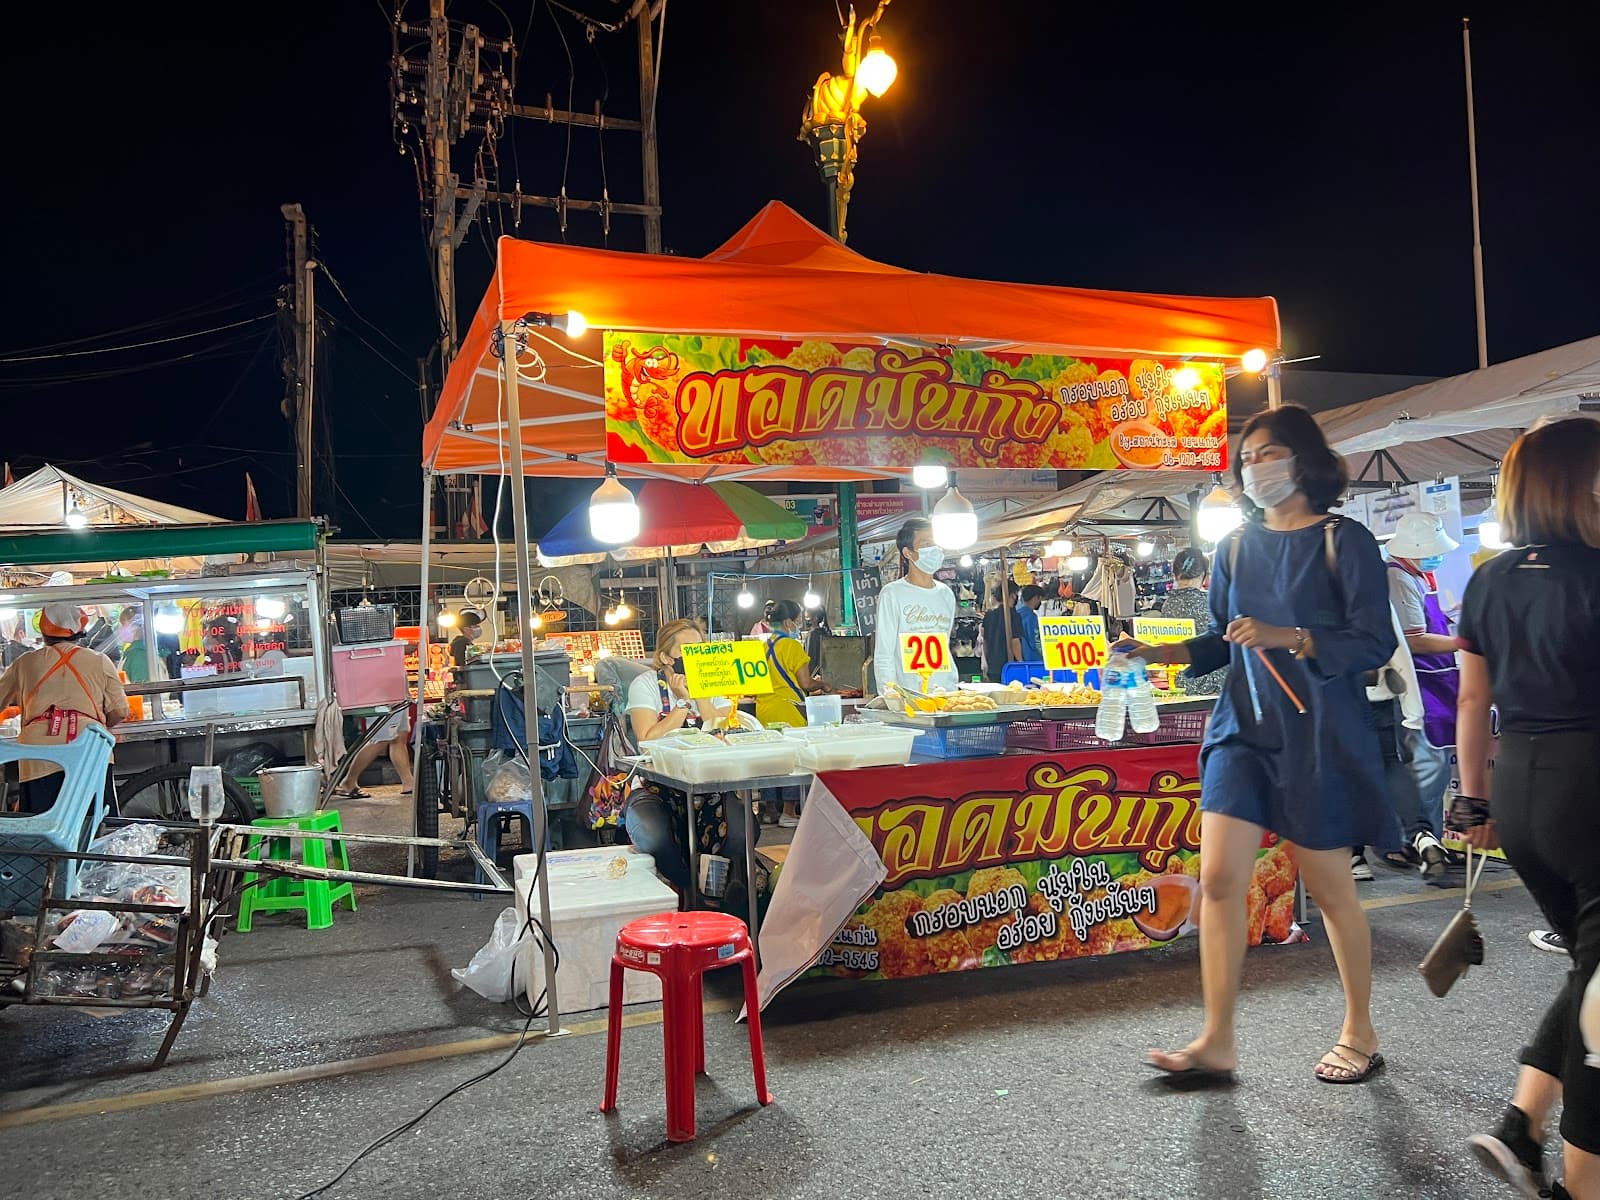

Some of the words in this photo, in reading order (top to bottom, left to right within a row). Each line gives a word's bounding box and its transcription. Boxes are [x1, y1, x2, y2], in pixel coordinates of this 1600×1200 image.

[1060, 377, 1129, 404] กรอบนอก
[1135, 365, 1180, 398] นุ่มใ
[680, 353, 1058, 454] ทอดมันกุ้ง
[1111, 395, 1148, 421] อร่อย
[785, 500, 796, 510] 03
[856, 573, 878, 590] เต้า
[1043, 618, 1101, 640] ทอดมันกุ้ง
[683, 643, 733, 657] ทะเลดอง
[907, 635, 943, 670] 20
[731, 658, 768, 686] 100
[853, 767, 1202, 883] อดมันกุ้
[913, 884, 1026, 937] กรอบนอก
[1038, 857, 1110, 912] นุ่มใน
[997, 907, 1056, 949] อร่อย
[1068, 882, 1156, 942] กุ้งเน้นๆ
